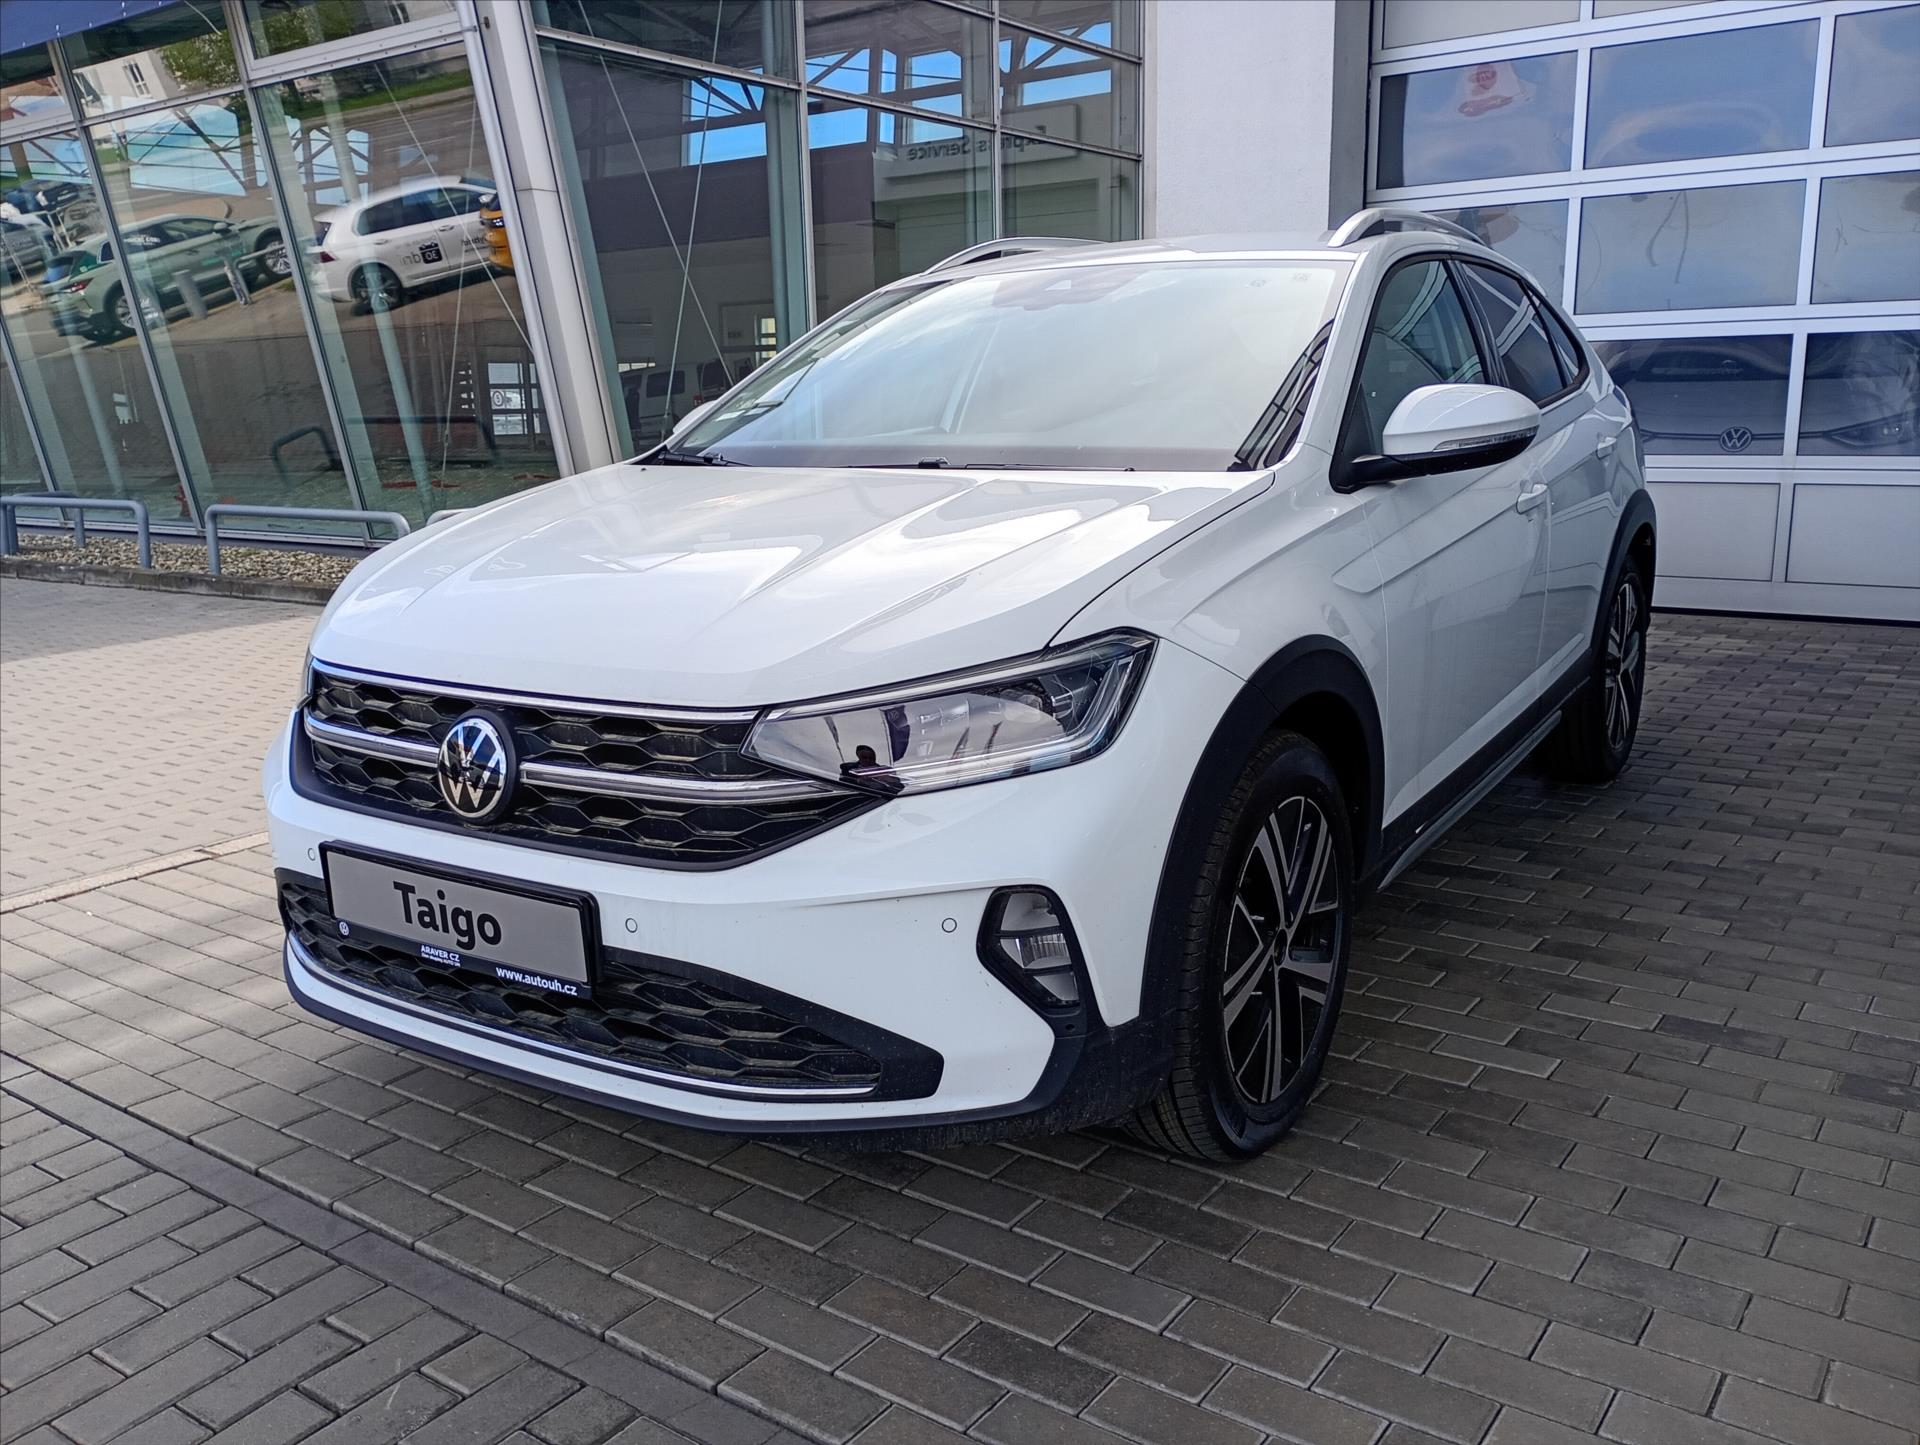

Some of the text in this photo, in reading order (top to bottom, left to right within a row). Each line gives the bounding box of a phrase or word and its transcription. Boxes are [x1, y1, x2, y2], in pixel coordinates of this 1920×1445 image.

[393, 881, 502, 950] Taigo
[420, 944, 449, 959] ARAVER
[449, 953, 460, 962] CZ
[495, 967, 578, 996] www.autouh.cz
